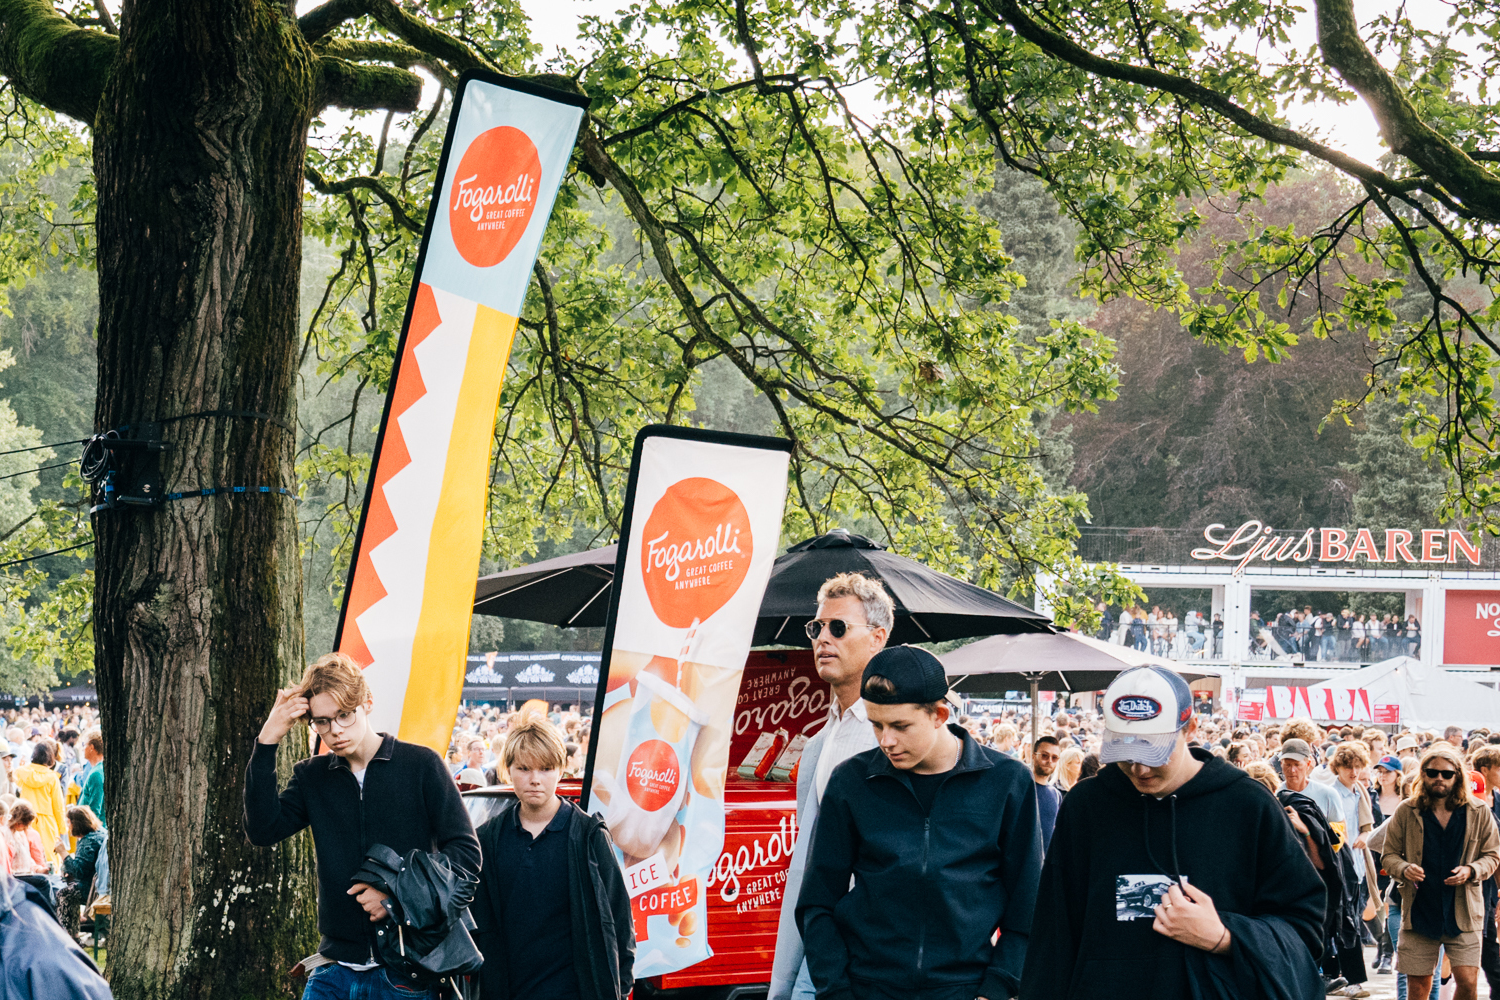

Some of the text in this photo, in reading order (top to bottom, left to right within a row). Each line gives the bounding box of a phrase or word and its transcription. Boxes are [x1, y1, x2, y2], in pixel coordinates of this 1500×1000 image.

[453, 173, 534, 222] Fogarolli
[477, 220, 506, 231] ANYWHERE
[486, 208, 526, 219] GREAT COFFEE
[645, 522, 741, 581] Fogarolli
[686, 560, 734, 578] GREAT COFFEE
[675, 577, 711, 590] ANYWHERE
[746, 666, 797, 690] ANYWHERE
[752, 685, 781, 701] GREAT
[1272, 685, 1331, 720] BAR
[628, 760, 677, 787] Fogarolli
[629, 863, 659, 890] ICE
[746, 875, 772, 895] GREAT
[639, 886, 692, 912] COFFEE
[736, 887, 781, 915] ANYWHERE
